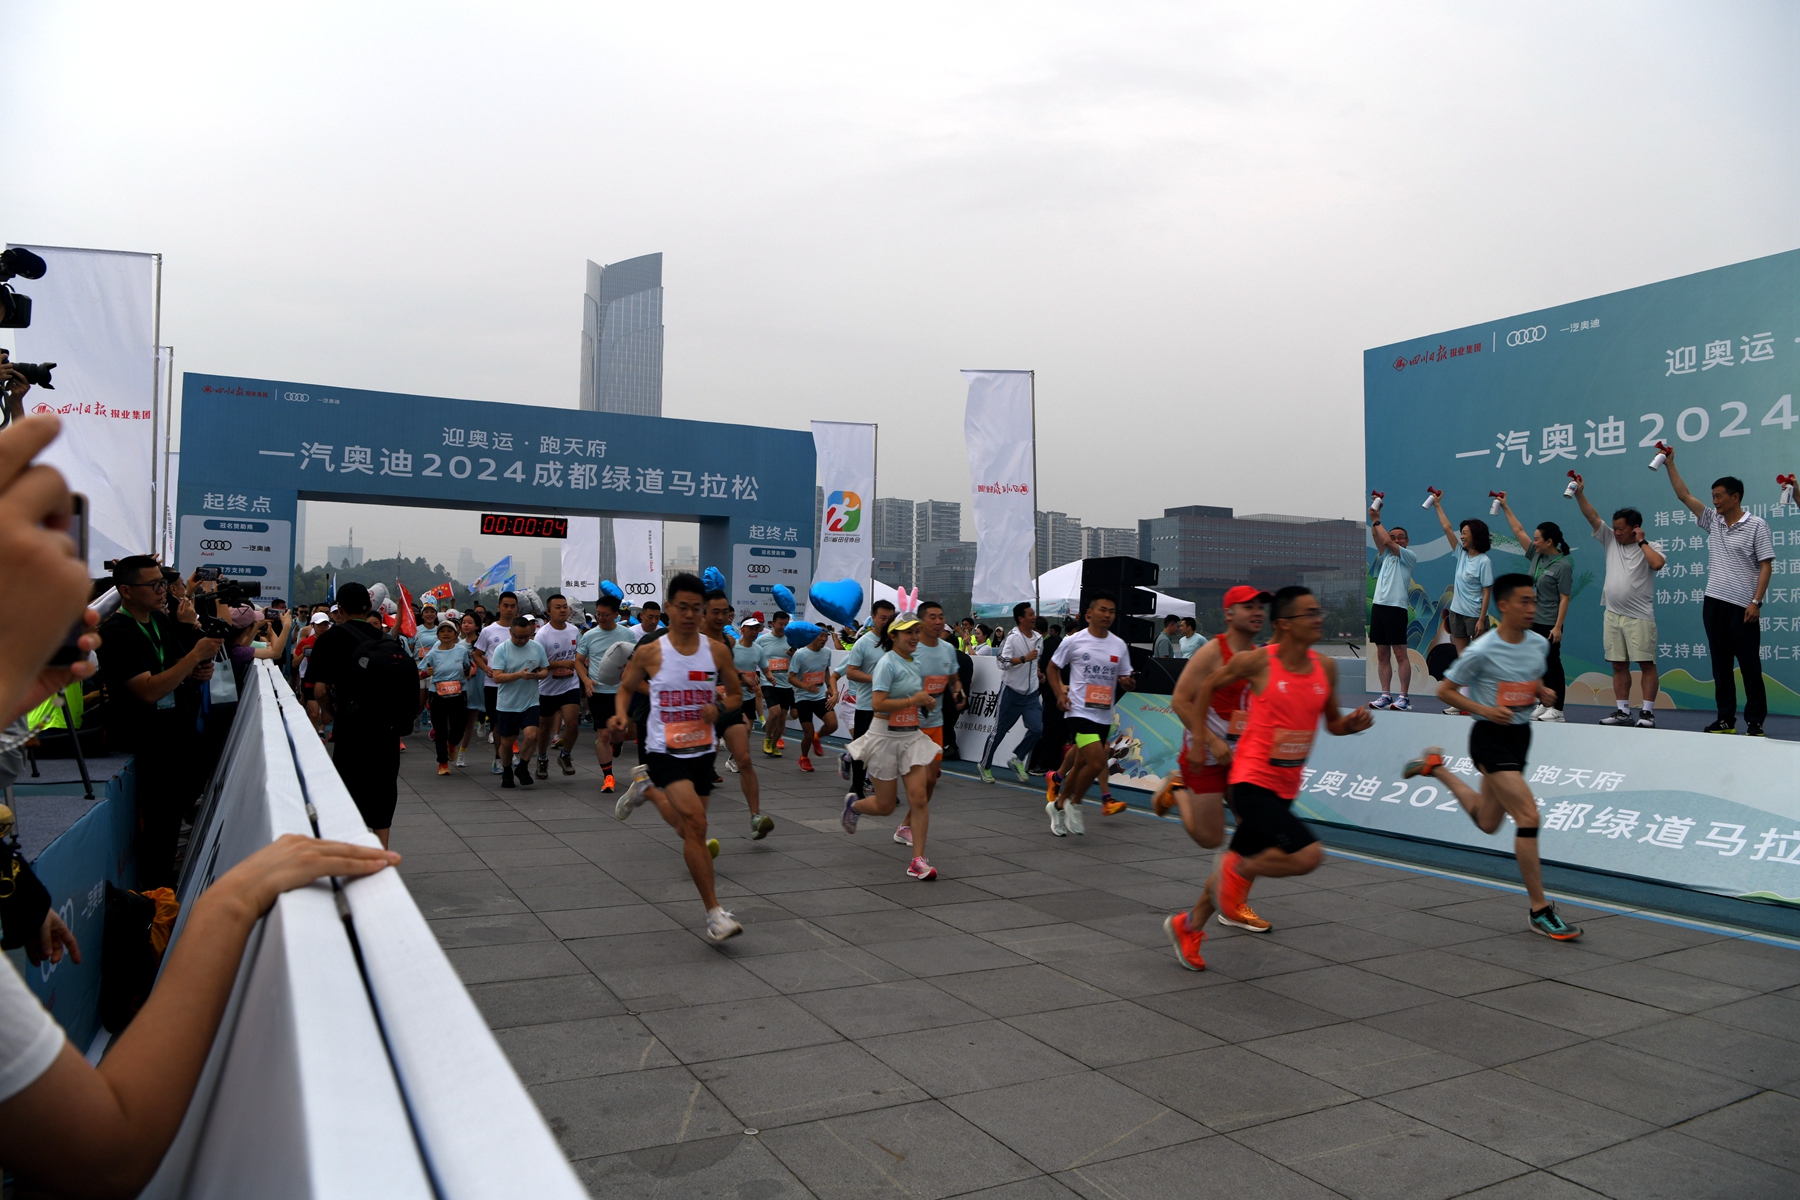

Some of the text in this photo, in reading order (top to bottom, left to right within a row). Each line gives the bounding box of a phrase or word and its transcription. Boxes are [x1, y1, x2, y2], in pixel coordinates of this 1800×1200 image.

[1559, 318, 1601, 333] 一汽奥迪
[1455, 394, 1799, 469] 一汽奥迪2024
[258, 442, 759, 501] 一汽奥迪2024成都绿道马拉松
[203, 492, 271, 513] 起终点
[220, 522, 253, 530] 冠名赞助商
[483, 515, 566, 536] 00:00:04
[749, 524, 798, 541] 起终点
[1656, 562, 1710, 578] 承办单
[961, 691, 998, 718] 面新
